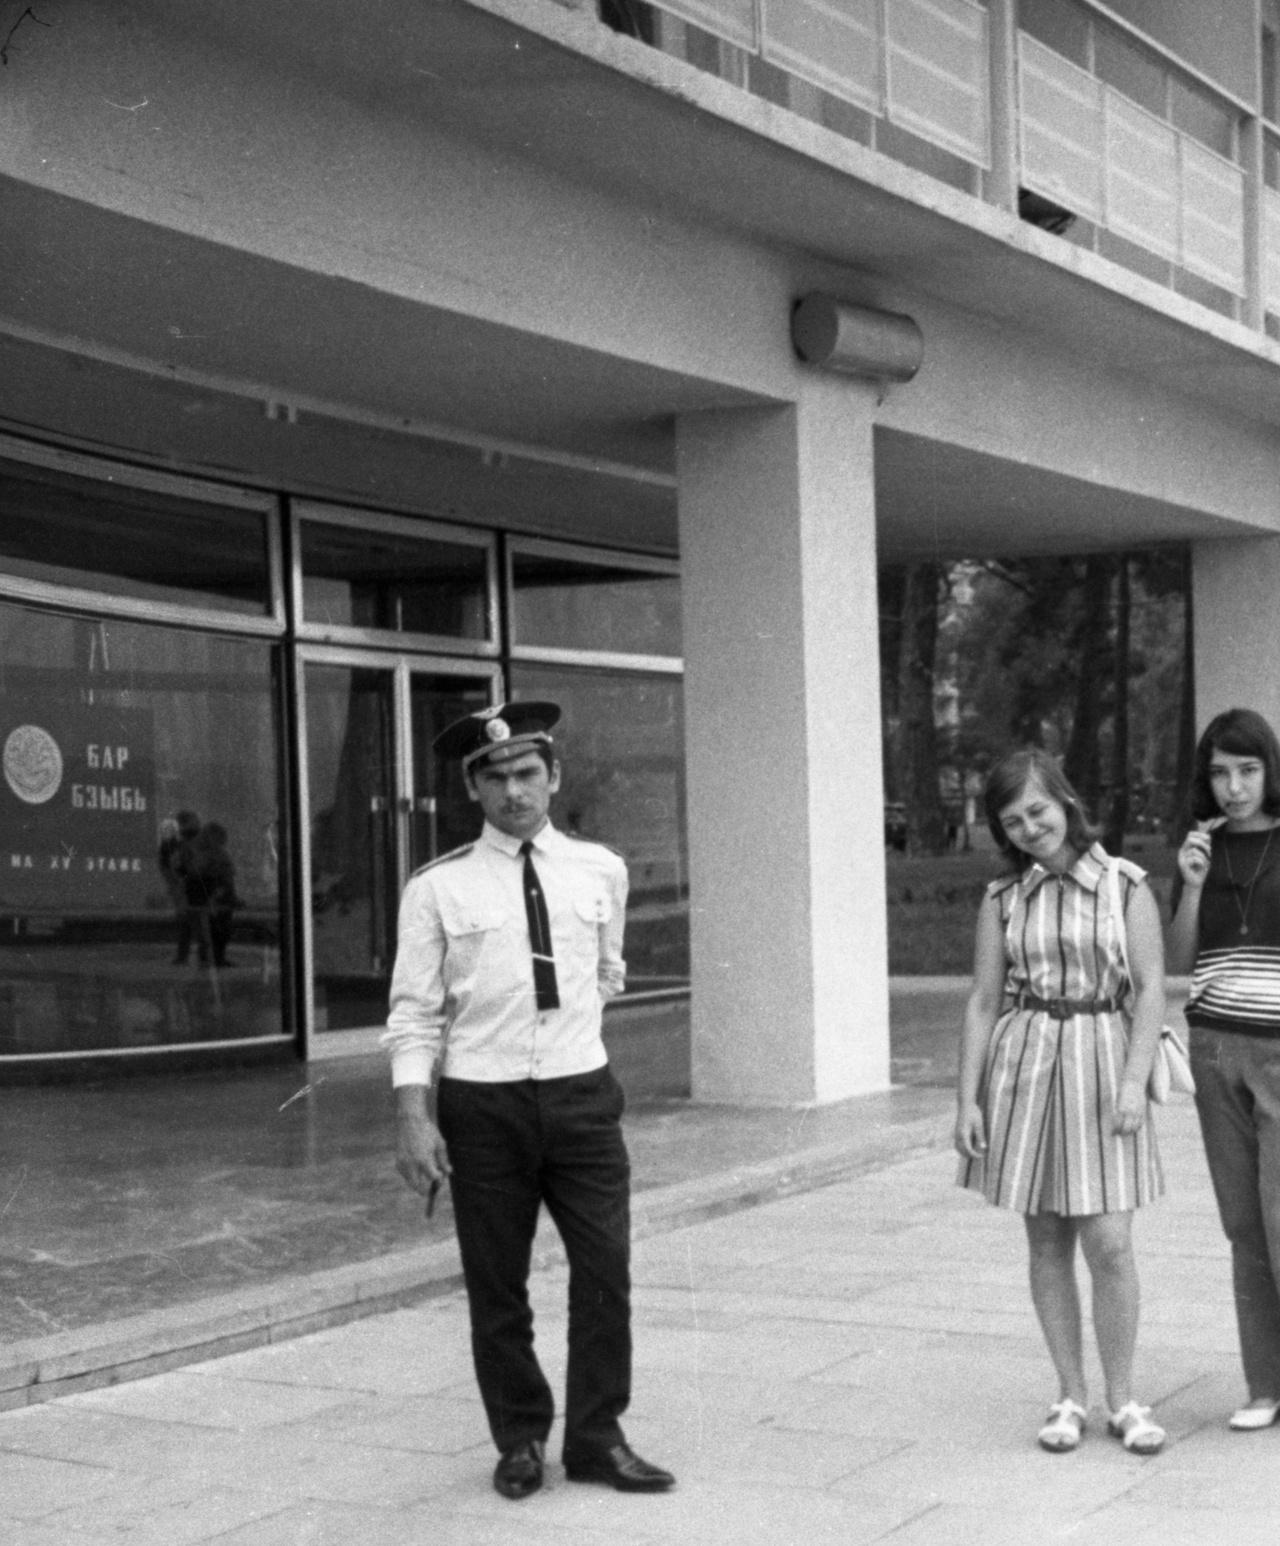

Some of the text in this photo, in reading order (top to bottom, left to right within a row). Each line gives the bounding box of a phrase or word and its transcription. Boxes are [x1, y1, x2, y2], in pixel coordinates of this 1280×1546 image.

[87, 744, 129, 770] БАР
[72, 784, 146, 811] БЗЫБЬ
[11, 854, 33, 868] НА
